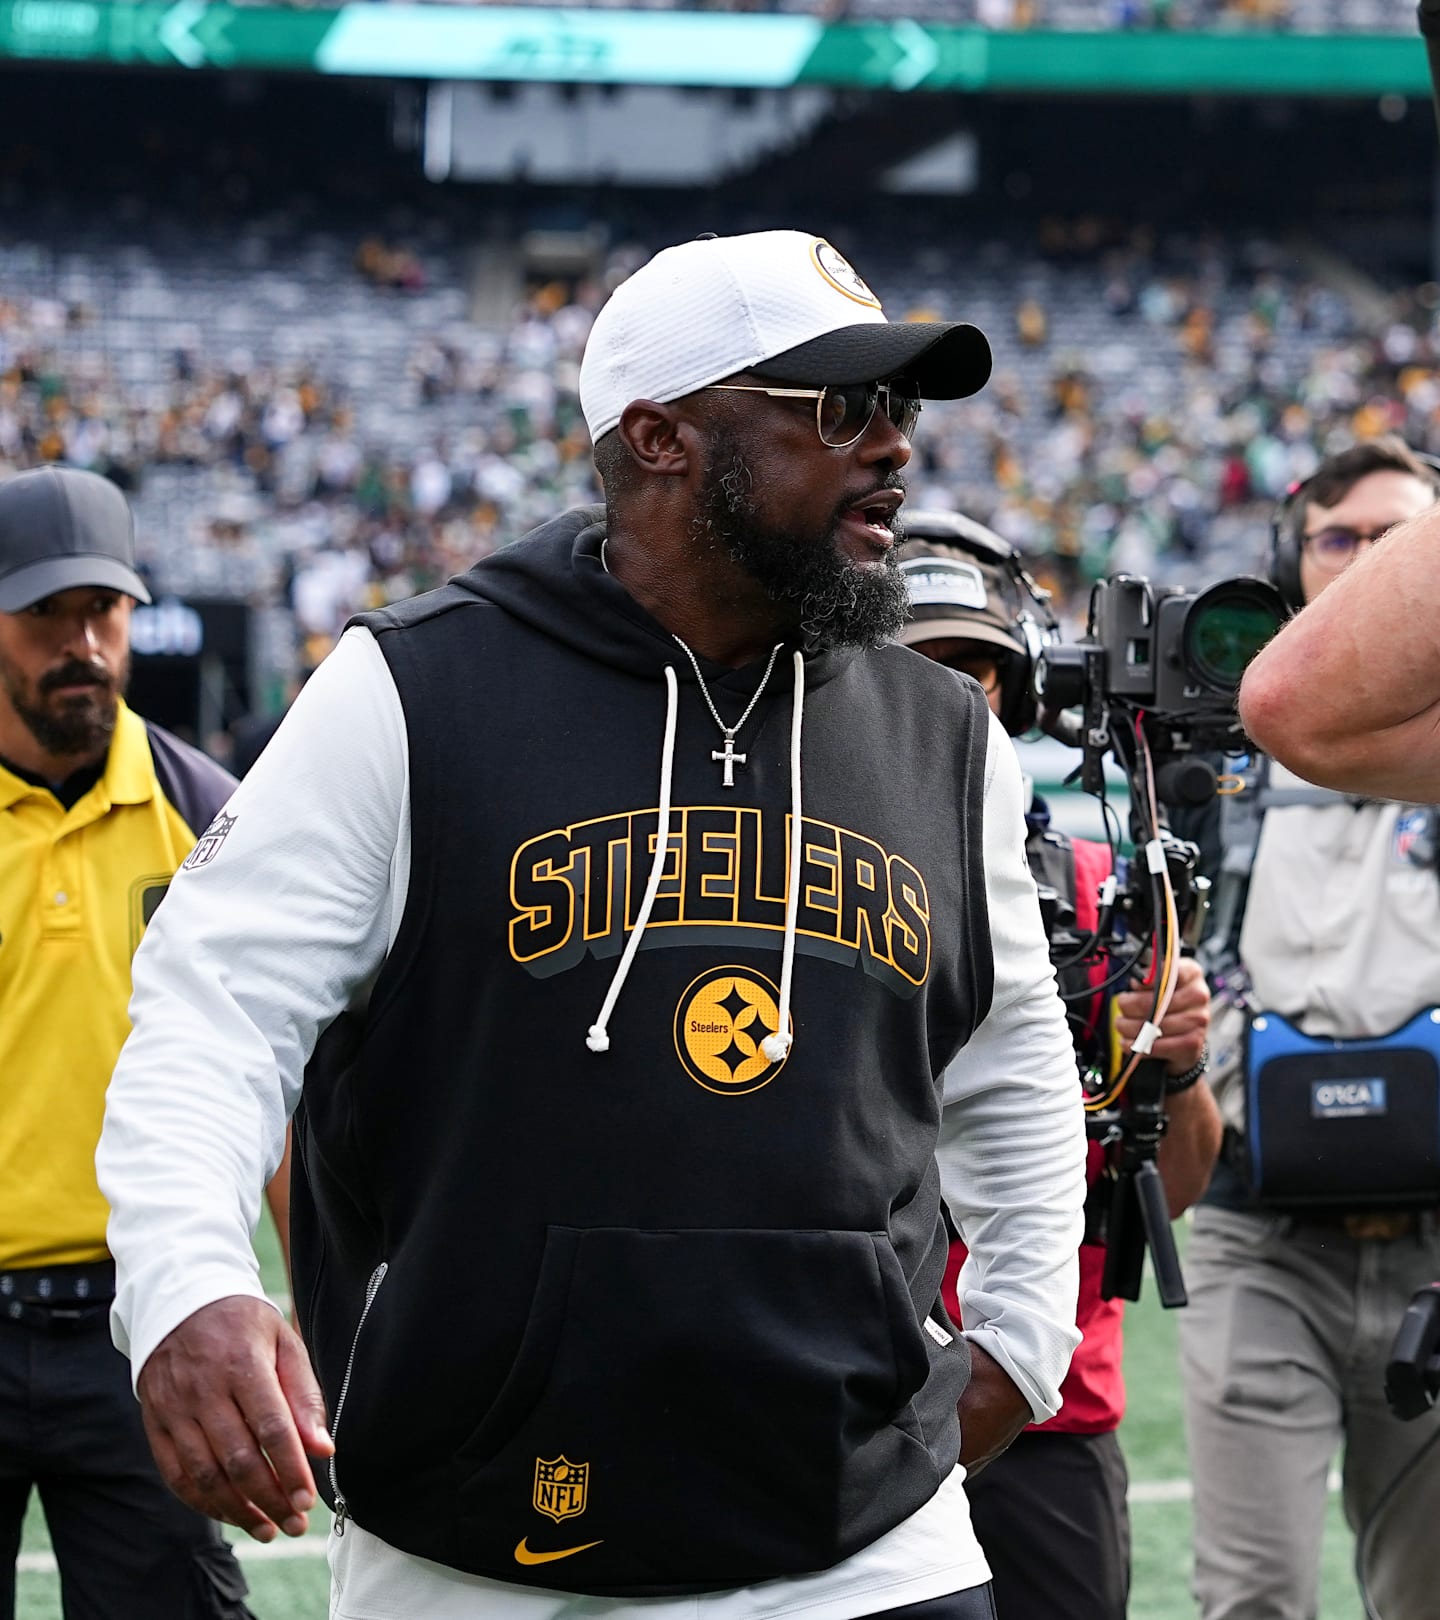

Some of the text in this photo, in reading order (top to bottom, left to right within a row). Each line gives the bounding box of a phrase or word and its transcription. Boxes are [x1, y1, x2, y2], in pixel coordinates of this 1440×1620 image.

[186, 838, 219, 865] NFL
[509, 806, 931, 986] STEELERS
[691, 1021, 729, 1034] Steelers
[539, 1483, 580, 1513] NFL
